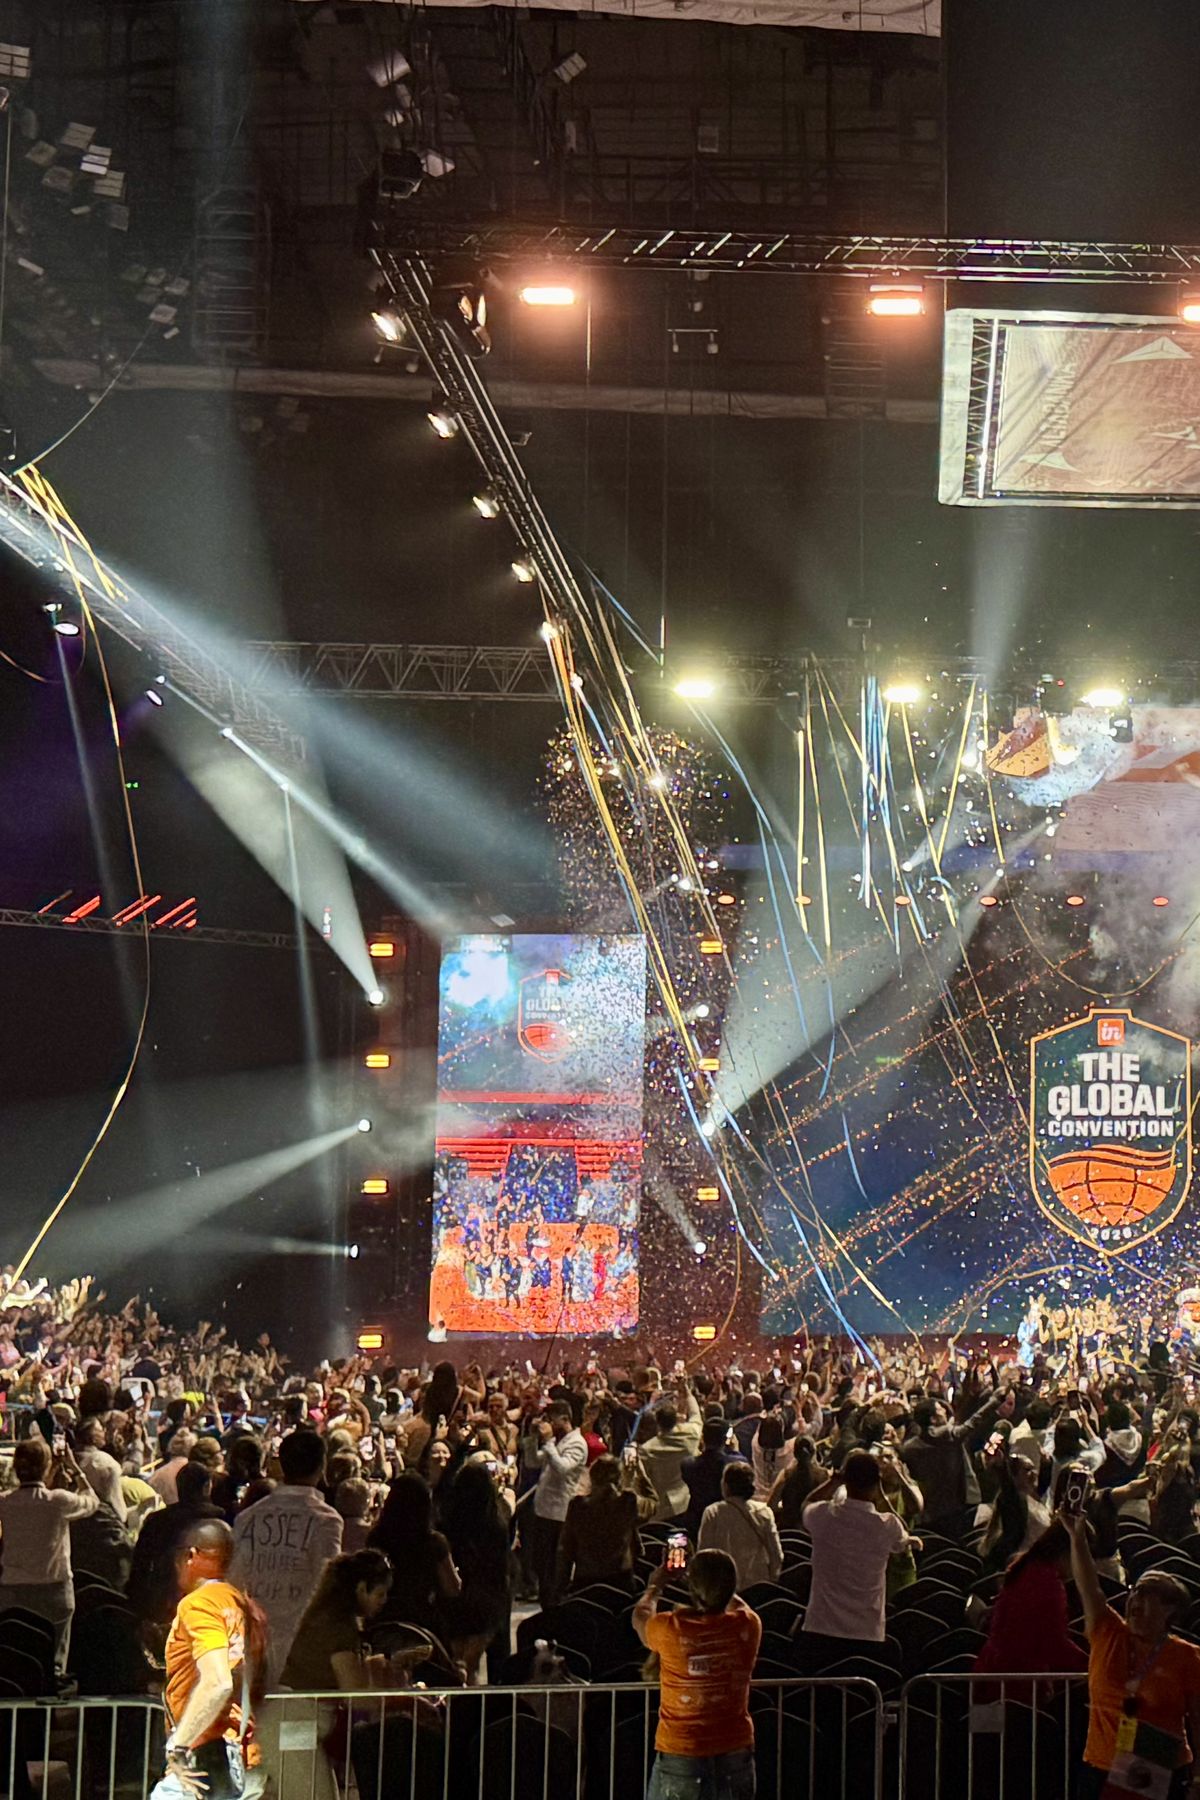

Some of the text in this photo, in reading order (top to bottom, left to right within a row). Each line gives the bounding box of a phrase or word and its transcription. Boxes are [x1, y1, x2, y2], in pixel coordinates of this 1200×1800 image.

[1077, 1052, 1141, 1082] THE
[1048, 1083, 1175, 1117] GLOBAL
[1047, 1120, 1174, 1137] CONVENTION
